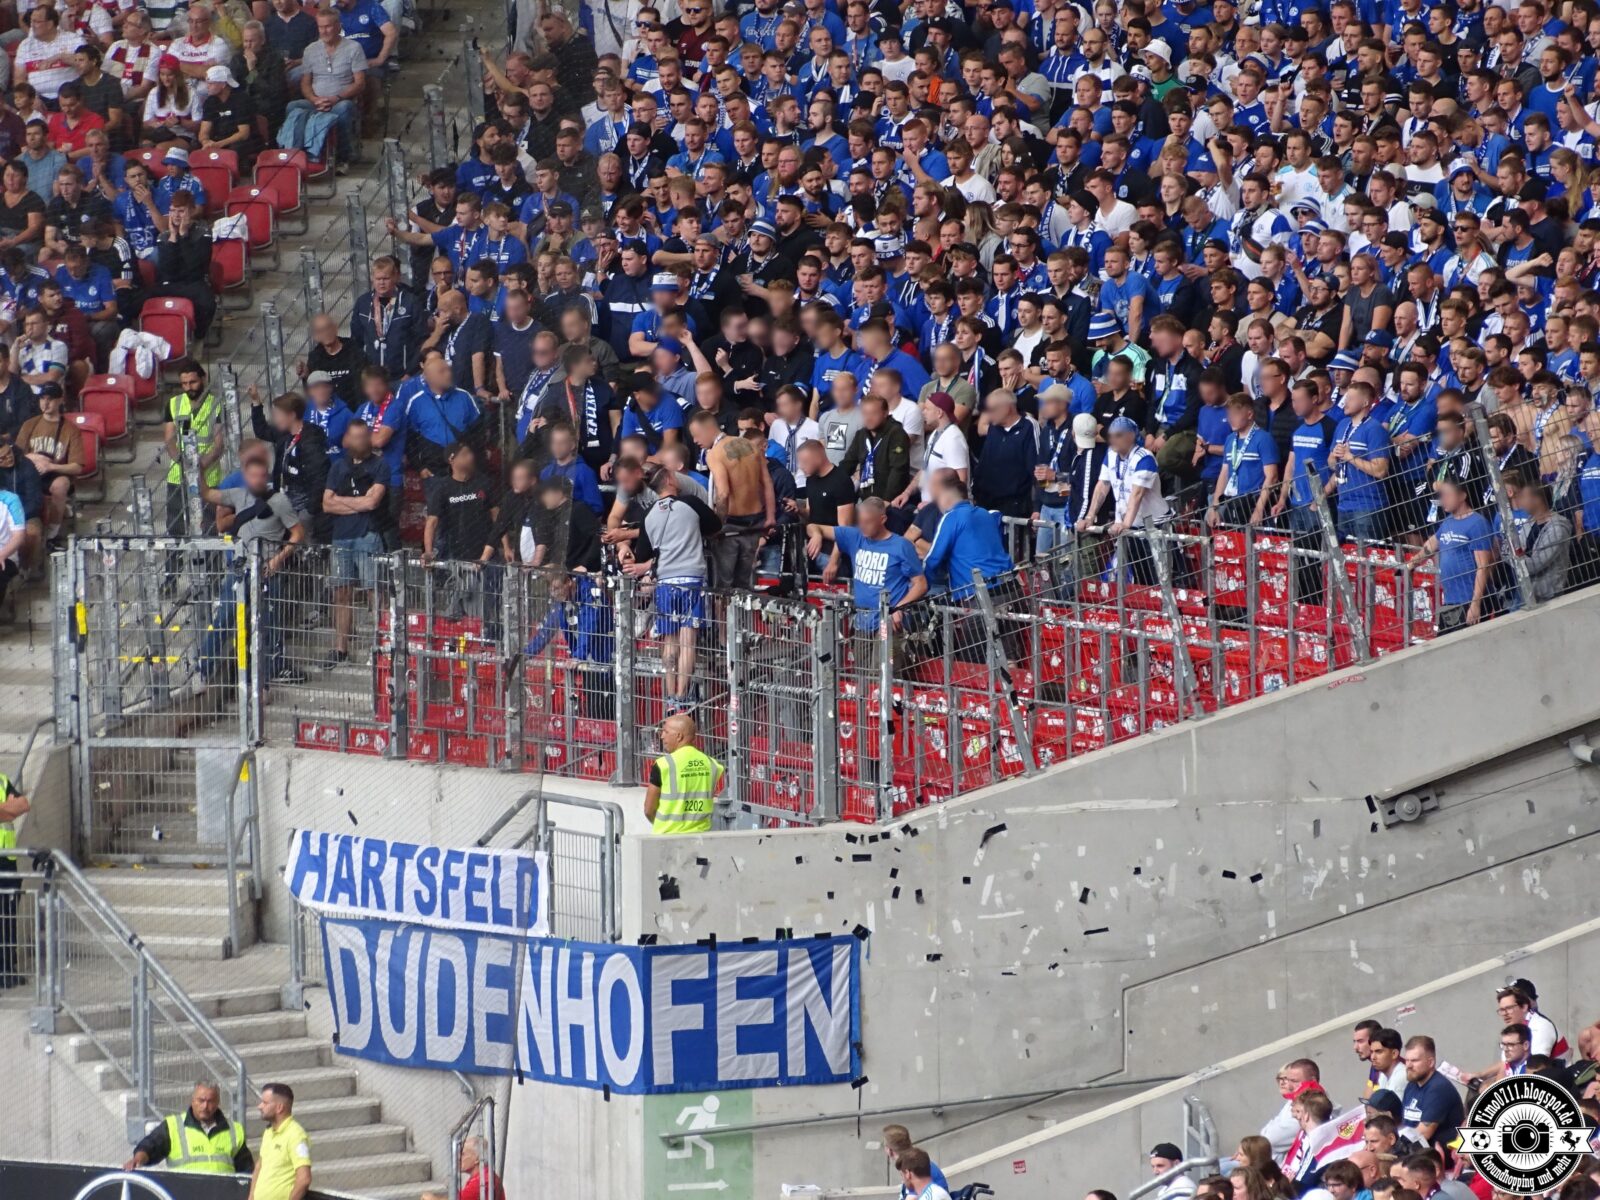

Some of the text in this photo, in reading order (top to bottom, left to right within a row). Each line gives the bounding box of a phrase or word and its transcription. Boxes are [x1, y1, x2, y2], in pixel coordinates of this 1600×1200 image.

[449, 492, 477, 503] Reebok
[855, 549, 889, 571] NORD
[684, 800, 703, 812] 2202
[290, 830, 539, 930] HÄRTSFELD
[325, 924, 851, 1087] DUDENHOFEN
